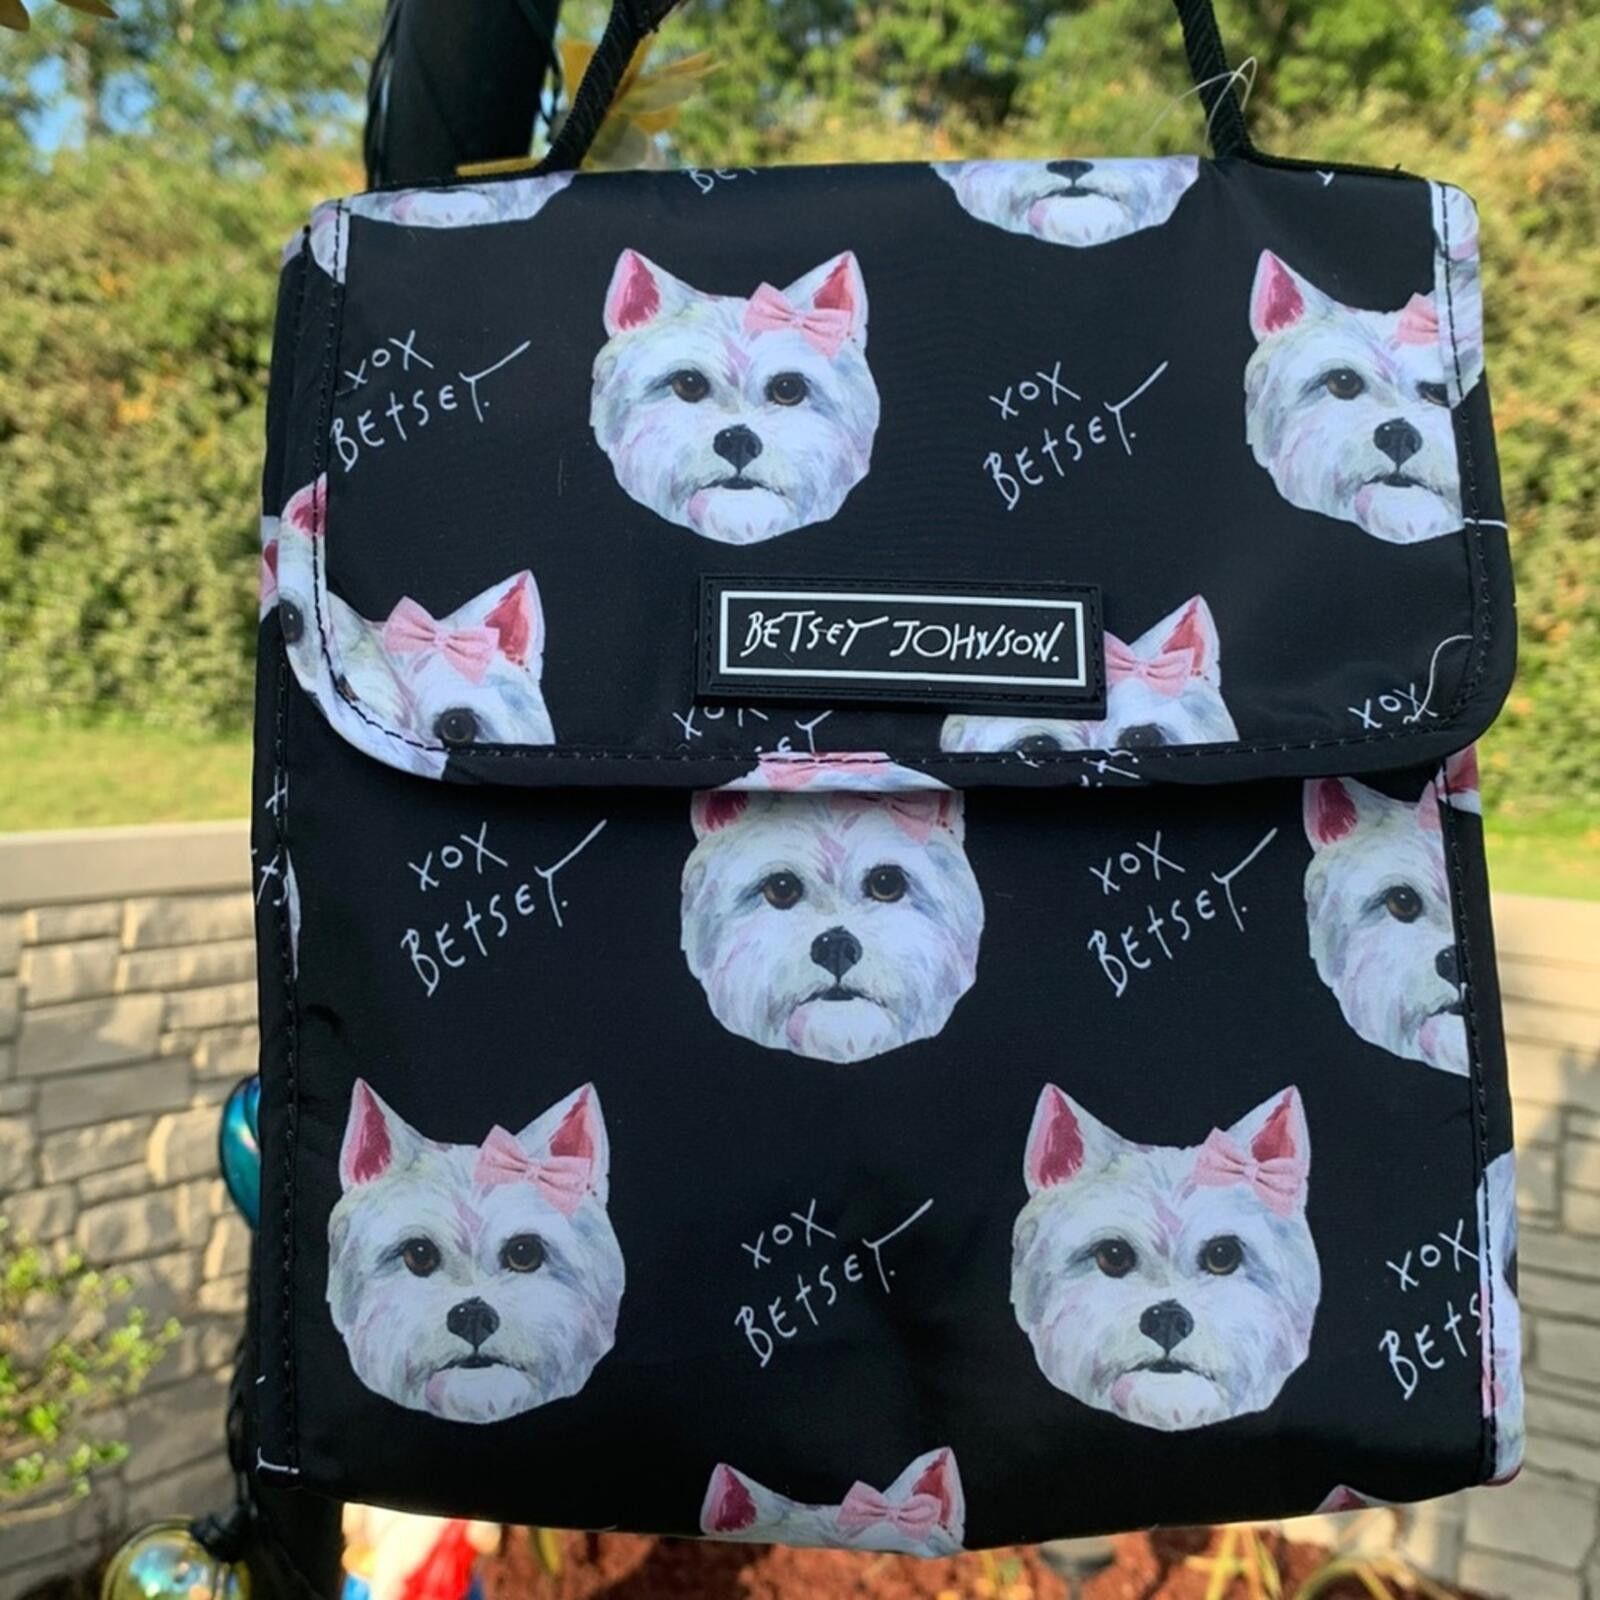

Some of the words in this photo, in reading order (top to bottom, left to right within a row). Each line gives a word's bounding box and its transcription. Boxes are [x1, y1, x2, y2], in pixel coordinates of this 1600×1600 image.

[344, 329, 434, 390] XOX
[988, 361, 1082, 420] XOX
[740, 610, 889, 658] BETSEY
[889, 619, 1065, 663] JOHNSON.
[408, 821, 509, 892] XOX
[1089, 831, 1186, 895] XOX
[741, 1198, 836, 1269] XOX
[1385, 1218, 1480, 1292] XOX
